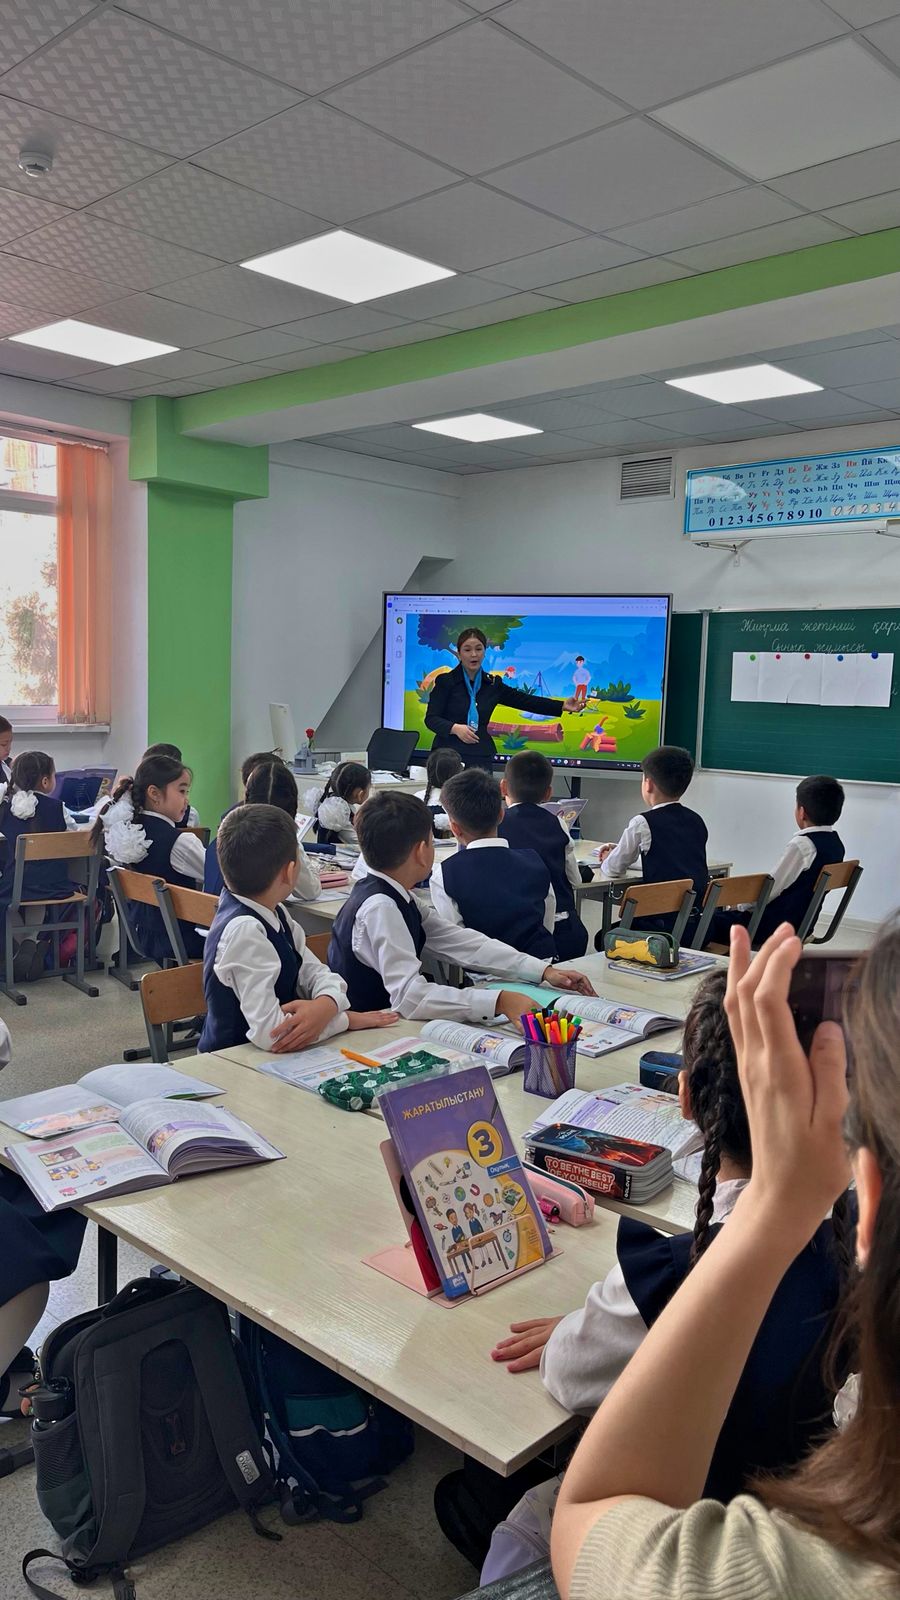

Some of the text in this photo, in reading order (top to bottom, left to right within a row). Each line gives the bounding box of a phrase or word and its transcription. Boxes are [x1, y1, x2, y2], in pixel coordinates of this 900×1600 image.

[709, 508, 822, 527] 0 1 2 3 4 5 6 7 8 9 10
[834, 501, 896, 516] 0 1 2 3 4
[402, 1087, 485, 1120] ЖАРАТЫЛЫСТАНУ
[472, 1129, 495, 1157] 3
[547, 1158, 612, 1184] TO BE THE BEST
